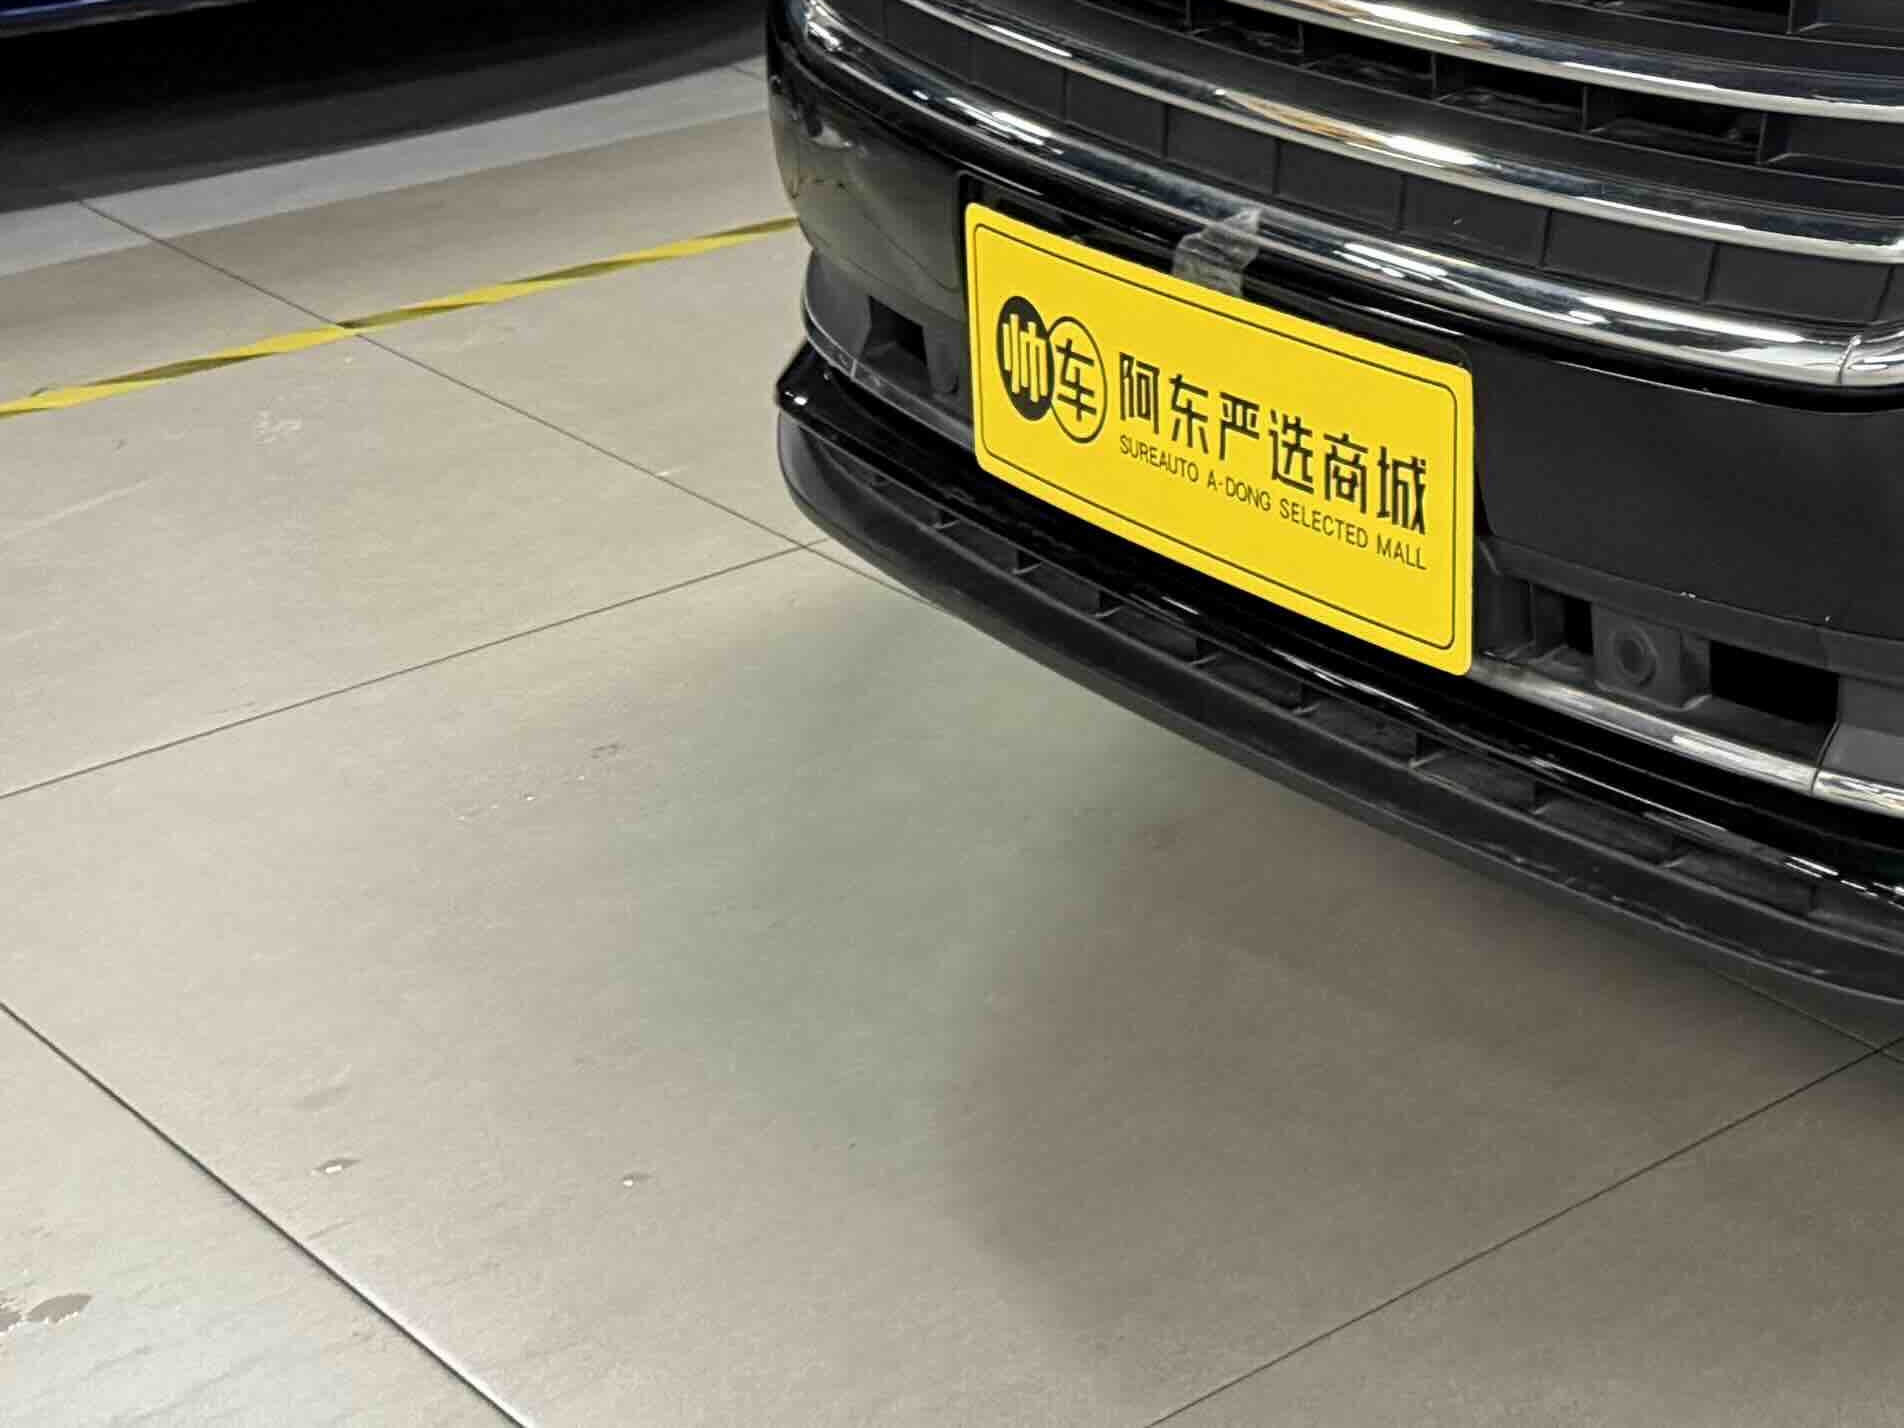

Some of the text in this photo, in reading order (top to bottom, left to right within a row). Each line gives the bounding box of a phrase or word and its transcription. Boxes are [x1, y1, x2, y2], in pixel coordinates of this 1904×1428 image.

[1119, 350, 1428, 535] 阿东严选商城
[1119, 434, 1200, 483] SUREAUTO
[1279, 497, 1369, 549] SELECTED
[1375, 532, 1428, 571] MALL
